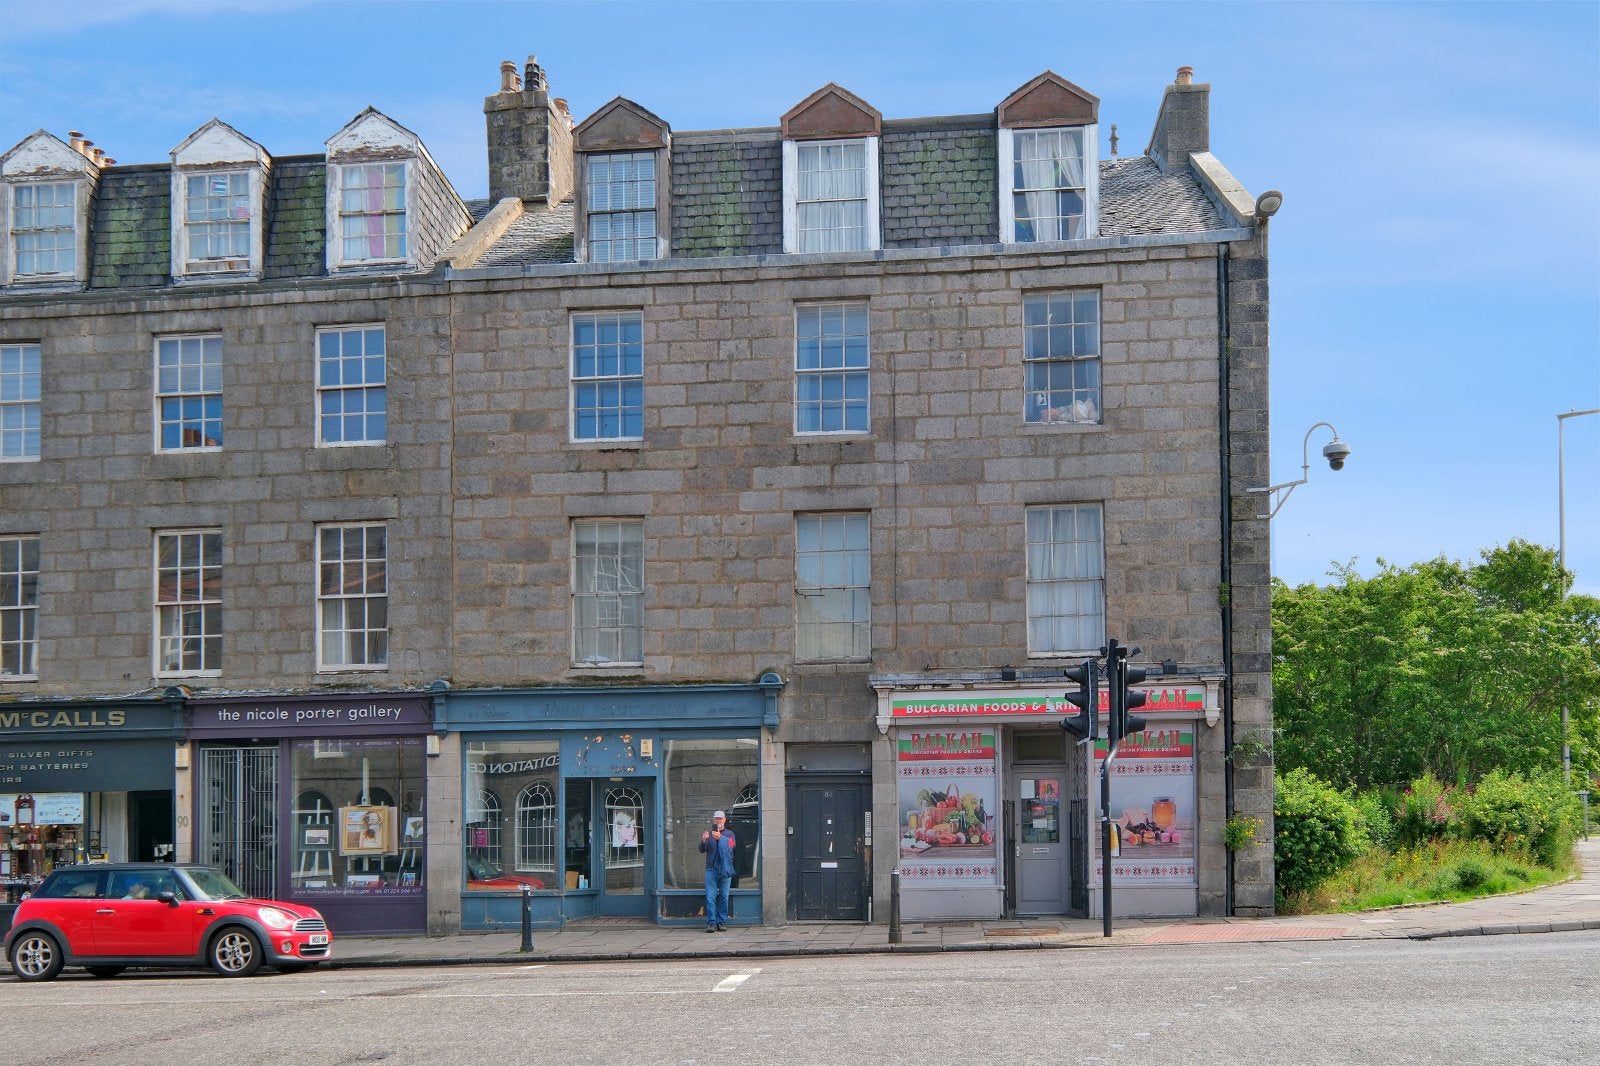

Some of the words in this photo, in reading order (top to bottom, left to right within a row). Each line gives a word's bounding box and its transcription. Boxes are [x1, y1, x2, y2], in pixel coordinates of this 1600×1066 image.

[1099, 688, 1188, 708] BKAN
[218, 708, 241, 721] the
[246, 706, 290, 721] nicole
[296, 707, 342, 723] porter
[348, 704, 402, 721] gallery
[906, 703, 978, 714] BULGARIAN
[983, 702, 1027, 712] FOODS
[1031, 701, 1041, 711] &
[1107, 729, 1181, 748] ALKAN
[20, 762, 89, 771] BATTERIES
[177, 815, 189, 828] 90
